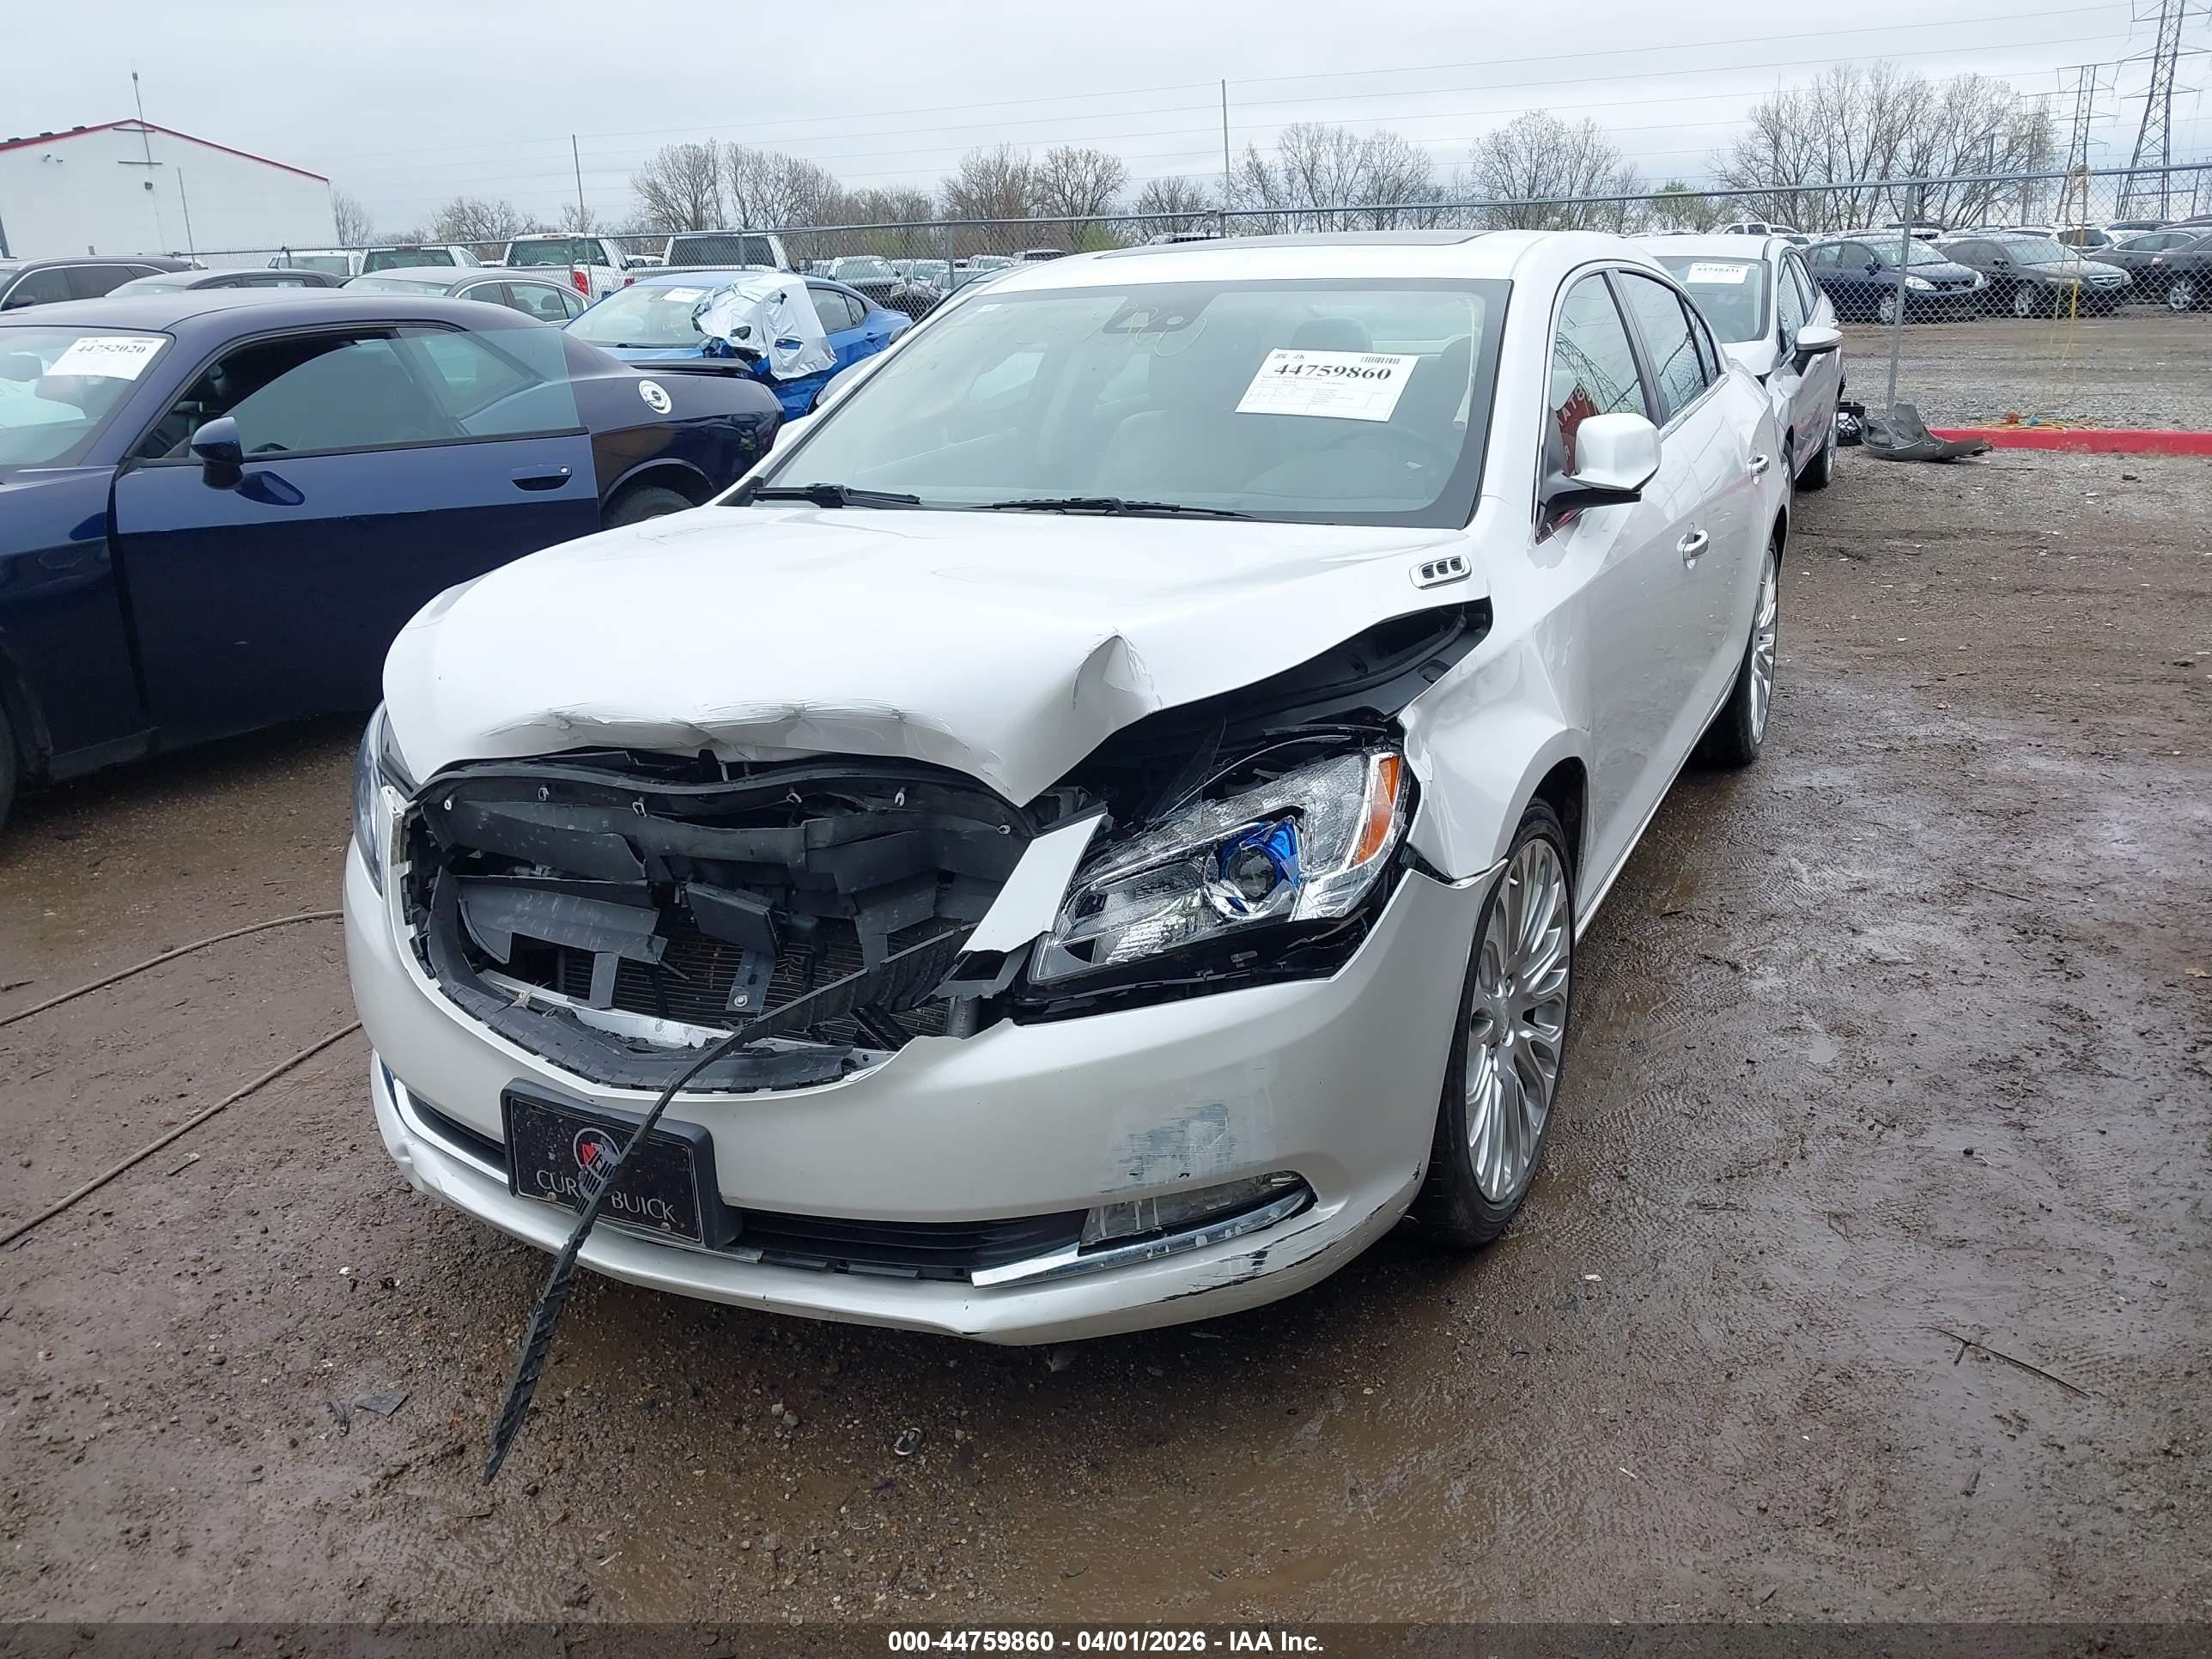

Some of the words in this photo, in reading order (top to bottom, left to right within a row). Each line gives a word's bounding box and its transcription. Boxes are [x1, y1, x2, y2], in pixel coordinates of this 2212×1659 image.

[76, 344, 147, 354] 44752020
[1273, 363, 1393, 380] 44759860
[536, 1170, 581, 1198] CUR
[611, 1190, 677, 1223] BUICK
